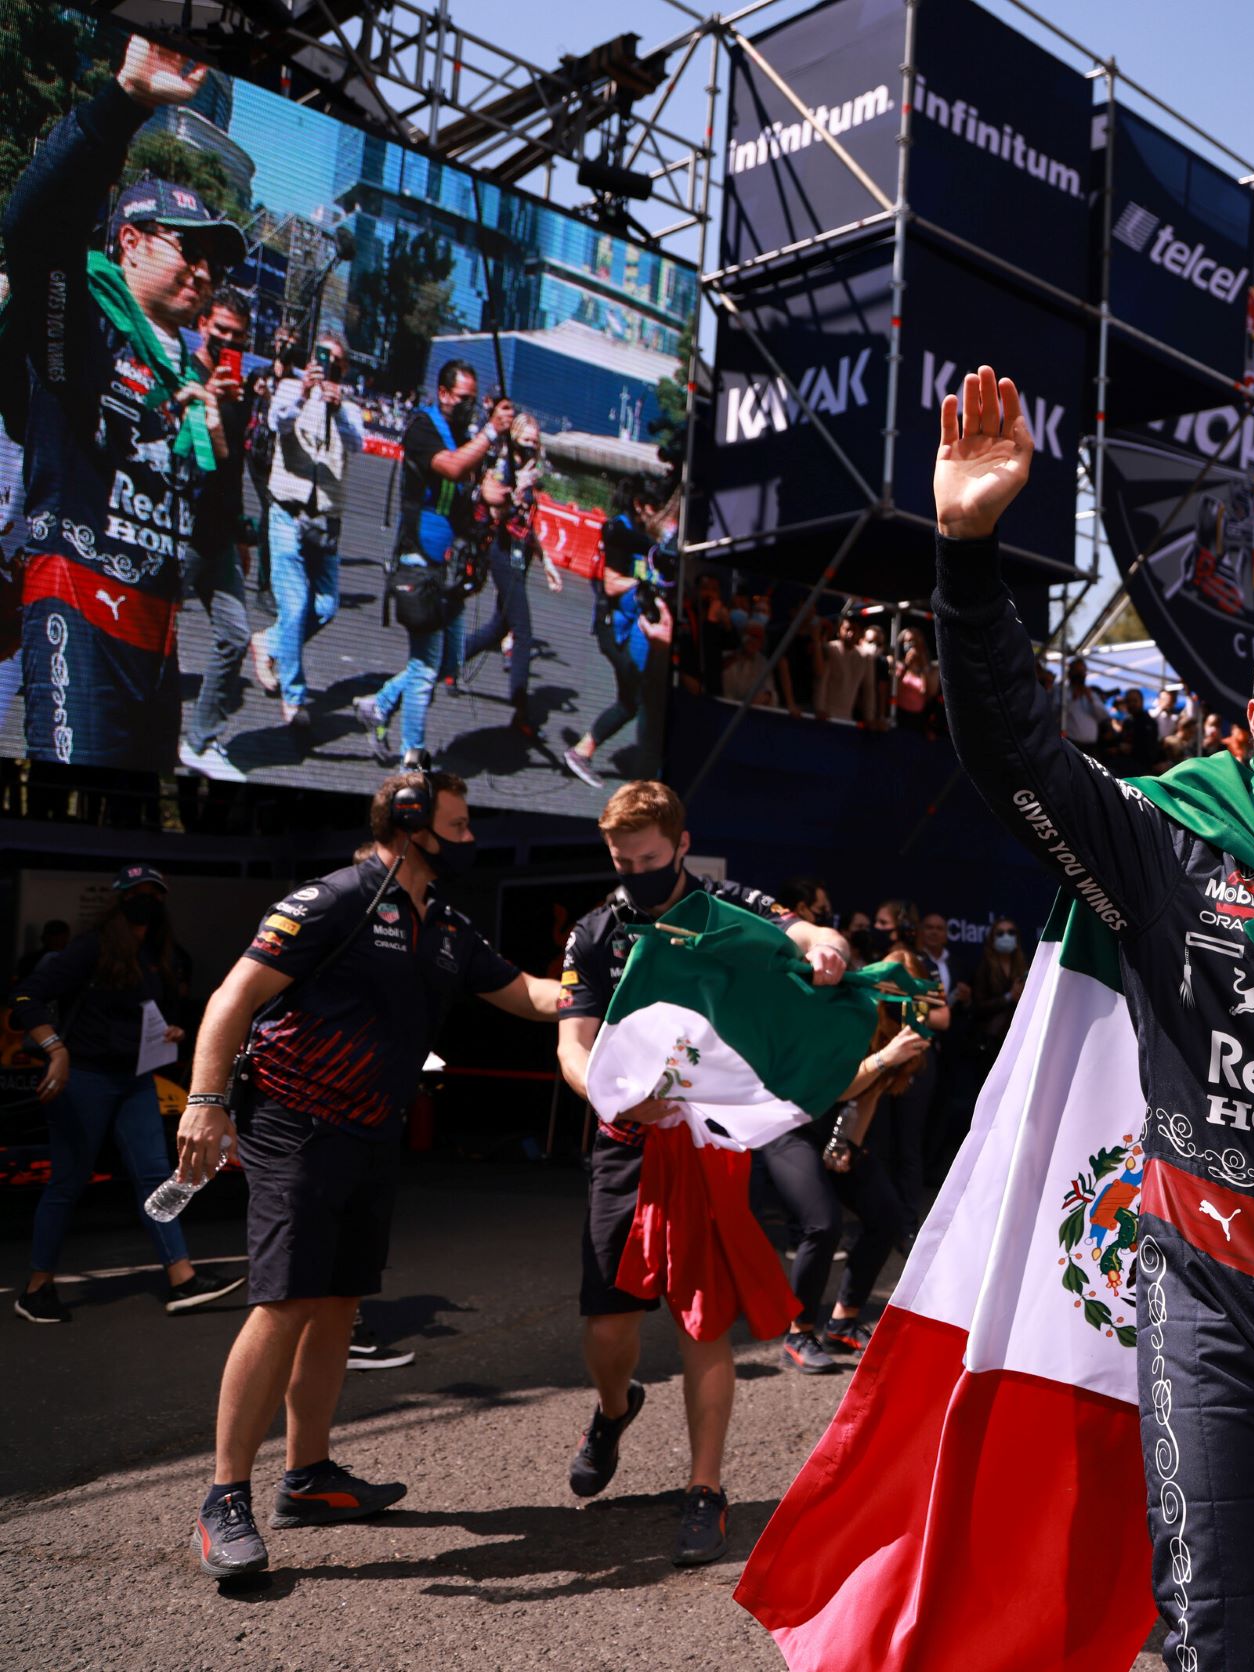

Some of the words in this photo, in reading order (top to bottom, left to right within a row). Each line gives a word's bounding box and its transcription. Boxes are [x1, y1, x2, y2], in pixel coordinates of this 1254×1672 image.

[1150, 224, 1249, 304] telcel
[725, 347, 872, 444] KAVAK
[108, 469, 172, 530] Red
[1012, 789, 1058, 840] GIVES
[1048, 840, 1087, 877] YOU
[1074, 876, 1128, 931] WINGS
[373, 924, 400, 938] Mobil
[1199, 910, 1244, 933] ORA
